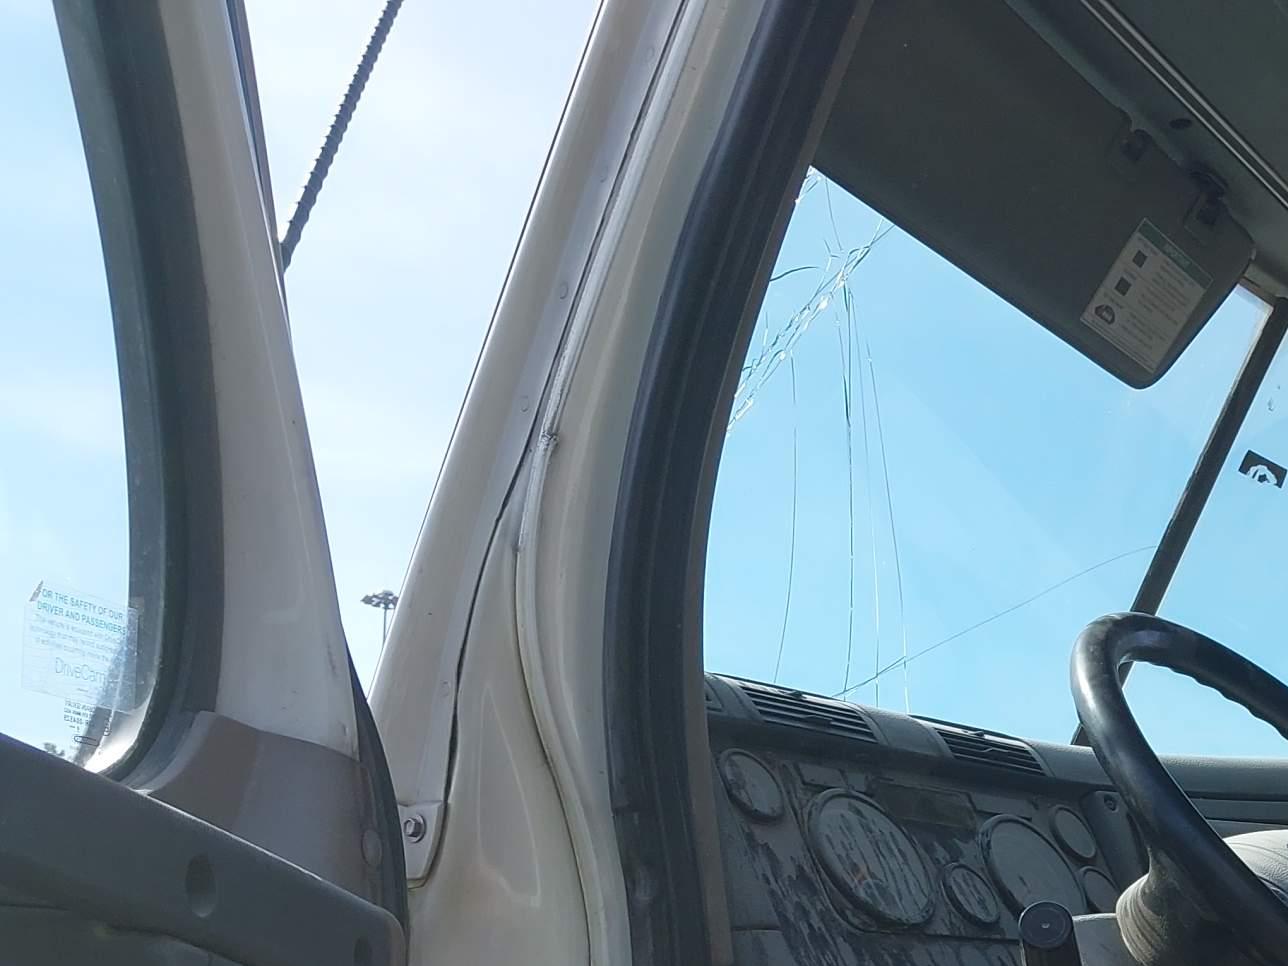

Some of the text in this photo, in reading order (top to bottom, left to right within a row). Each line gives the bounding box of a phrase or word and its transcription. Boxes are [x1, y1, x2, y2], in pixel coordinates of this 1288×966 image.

[37, 600, 126, 635] DRIVER AND PASSENGERS
[54, 591, 69, 605] THE
[70, 598, 97, 613] SAFETY
[98, 605, 108, 616] OF
[109, 609, 123, 620] OUR
